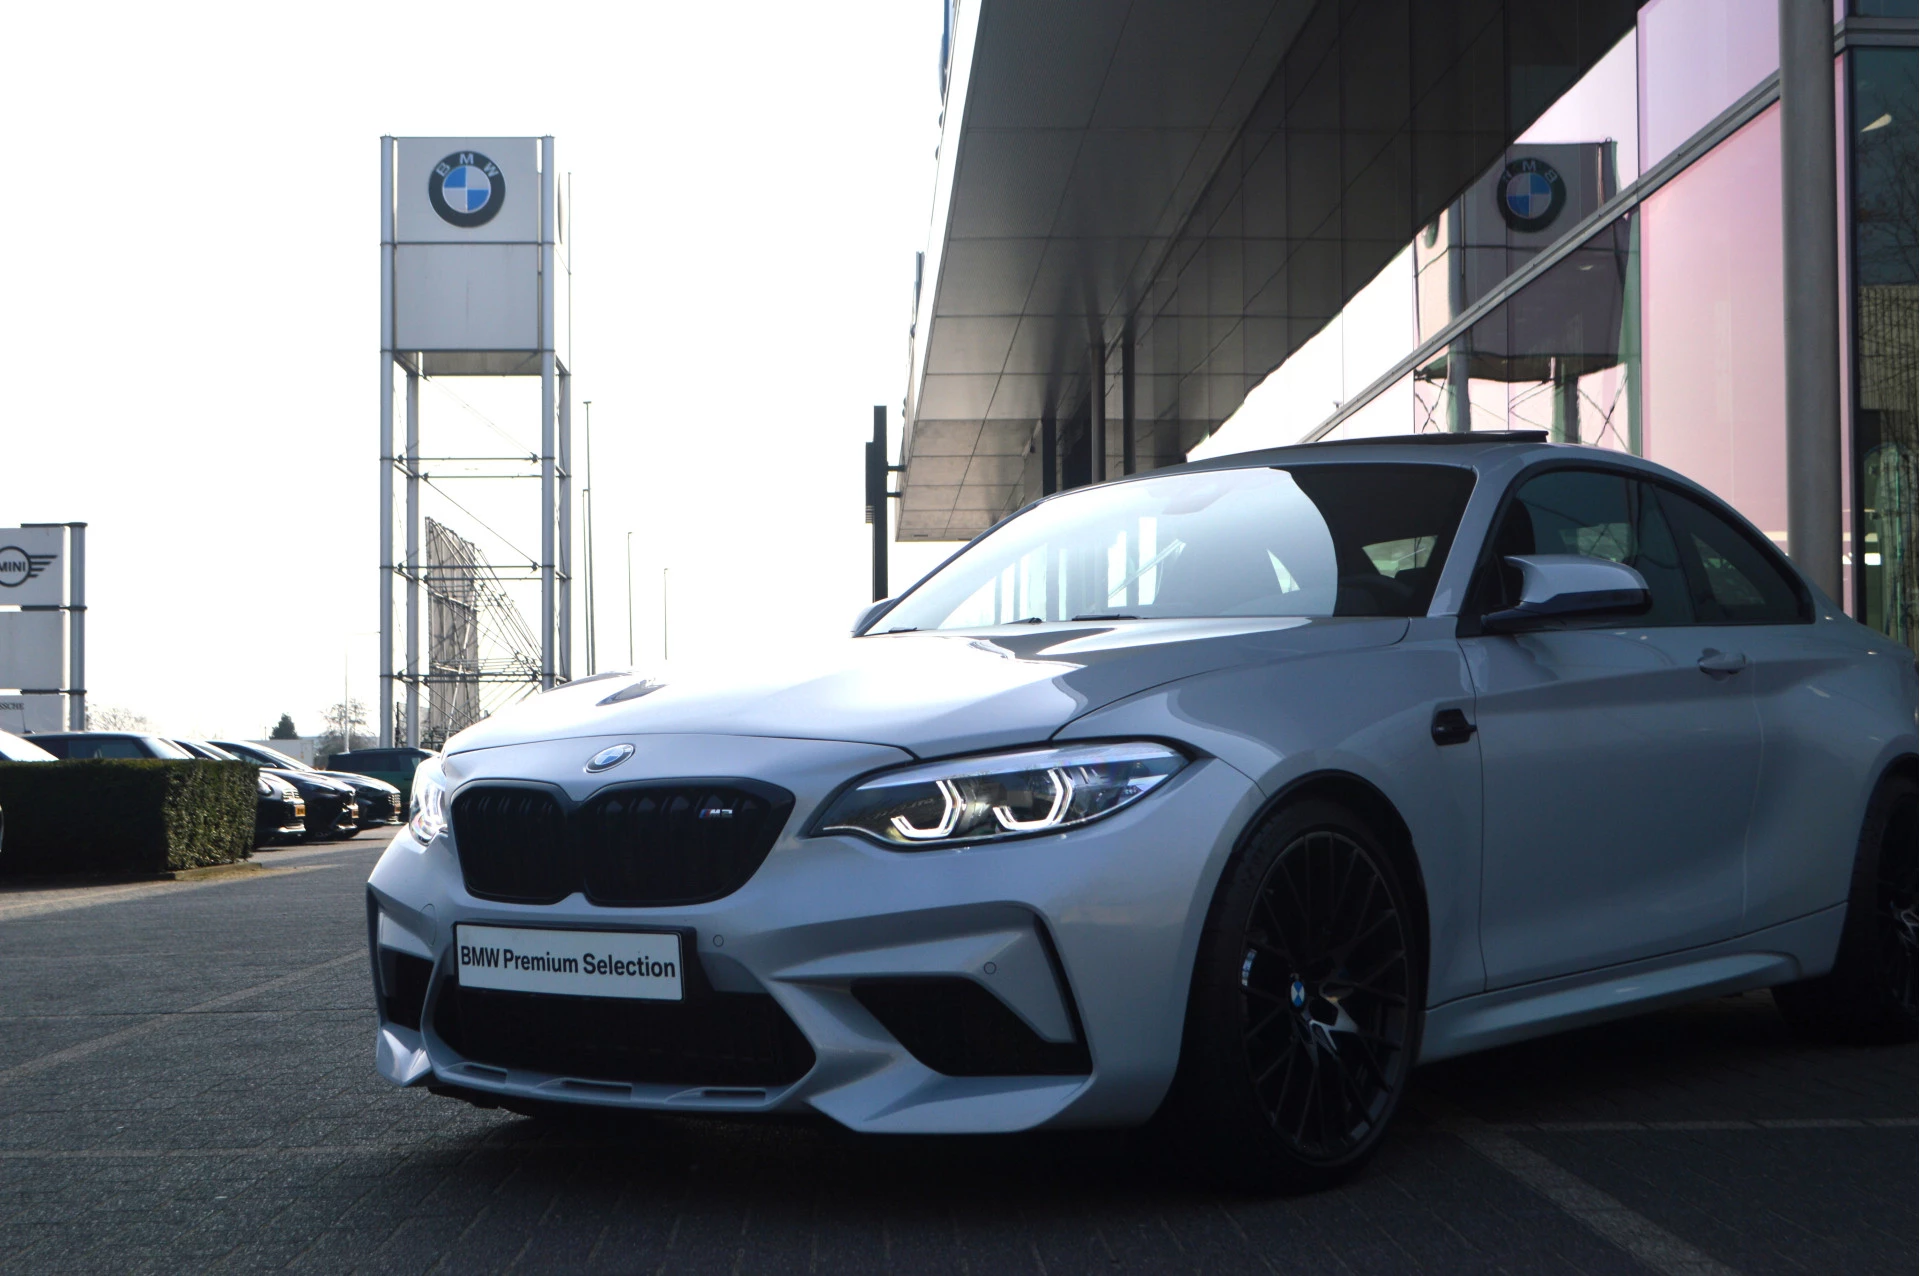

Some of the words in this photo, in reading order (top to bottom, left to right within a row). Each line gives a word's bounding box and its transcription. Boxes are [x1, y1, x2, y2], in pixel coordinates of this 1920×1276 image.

[435, 153, 499, 178] BMW
[0, 561, 26, 572] MINI
[461, 946, 500, 968] BMW
[503, 949, 579, 974] Premium
[583, 953, 676, 978] Selection
